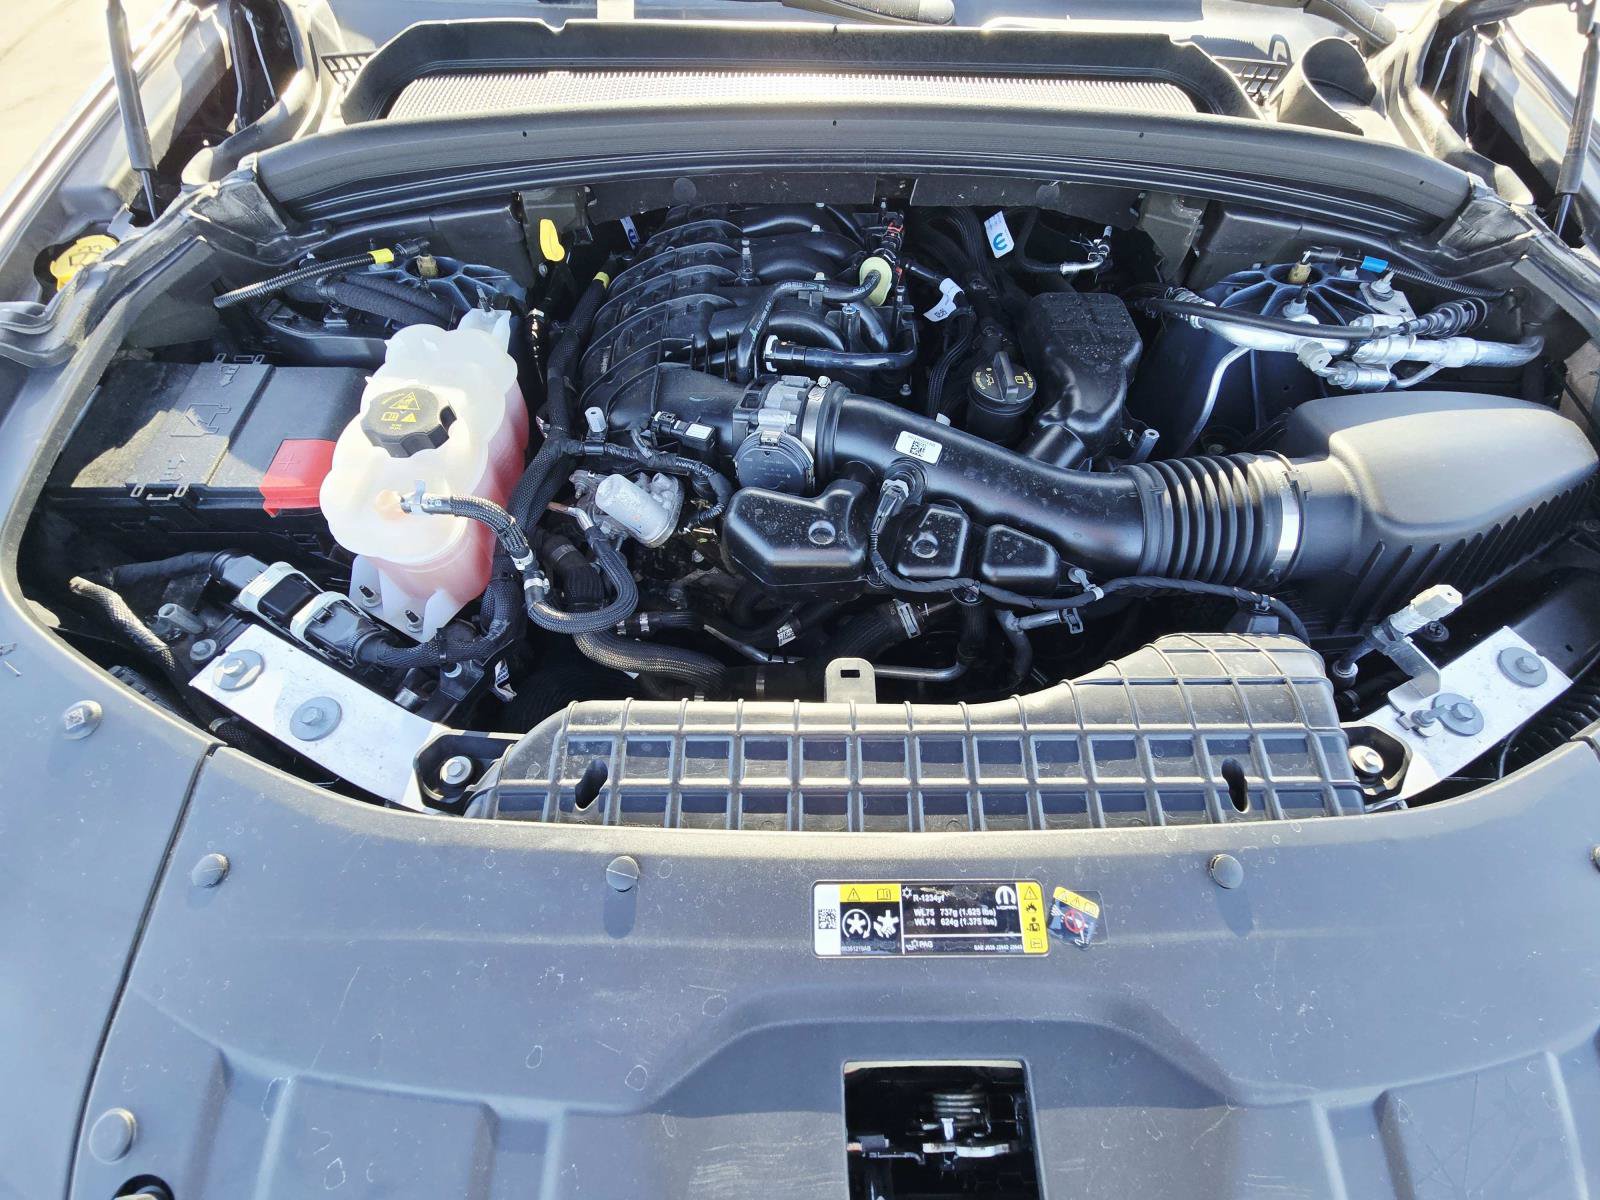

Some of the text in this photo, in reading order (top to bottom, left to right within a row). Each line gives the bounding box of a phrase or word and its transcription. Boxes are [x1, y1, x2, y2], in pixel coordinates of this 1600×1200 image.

[912, 894, 945, 903] R-1234yf
[913, 908, 997, 918] WL75 737g (1.625 lbs)
[913, 918, 998, 928] WL74 624g (1.375 lbs)
